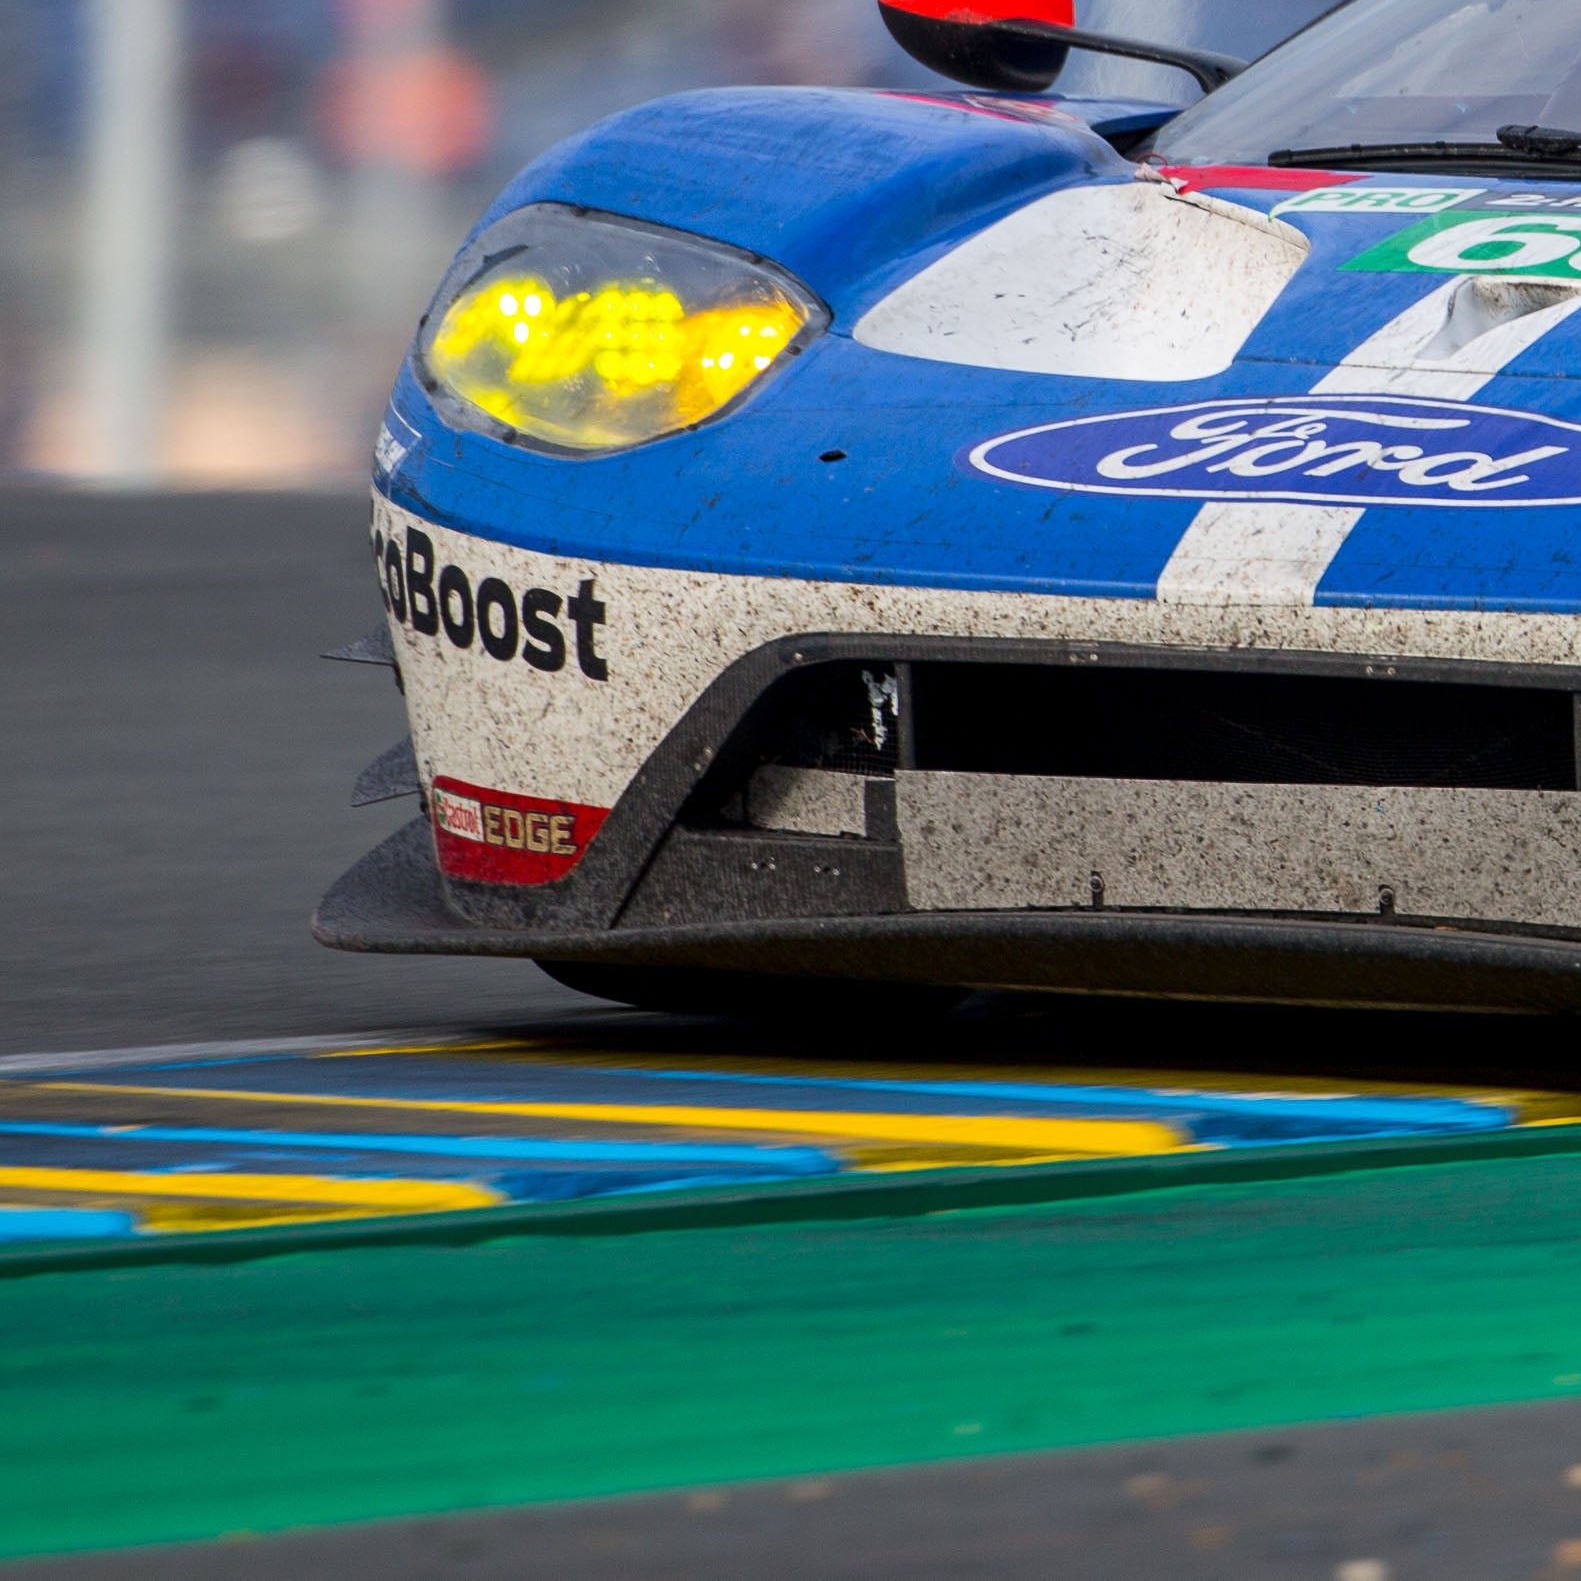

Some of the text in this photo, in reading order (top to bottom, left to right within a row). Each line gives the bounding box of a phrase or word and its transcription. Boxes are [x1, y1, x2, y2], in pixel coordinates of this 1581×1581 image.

[1291, 192, 1459, 208] PRO
[1096, 408, 1567, 491] Ford
[484, 804, 578, 856] EDGE
